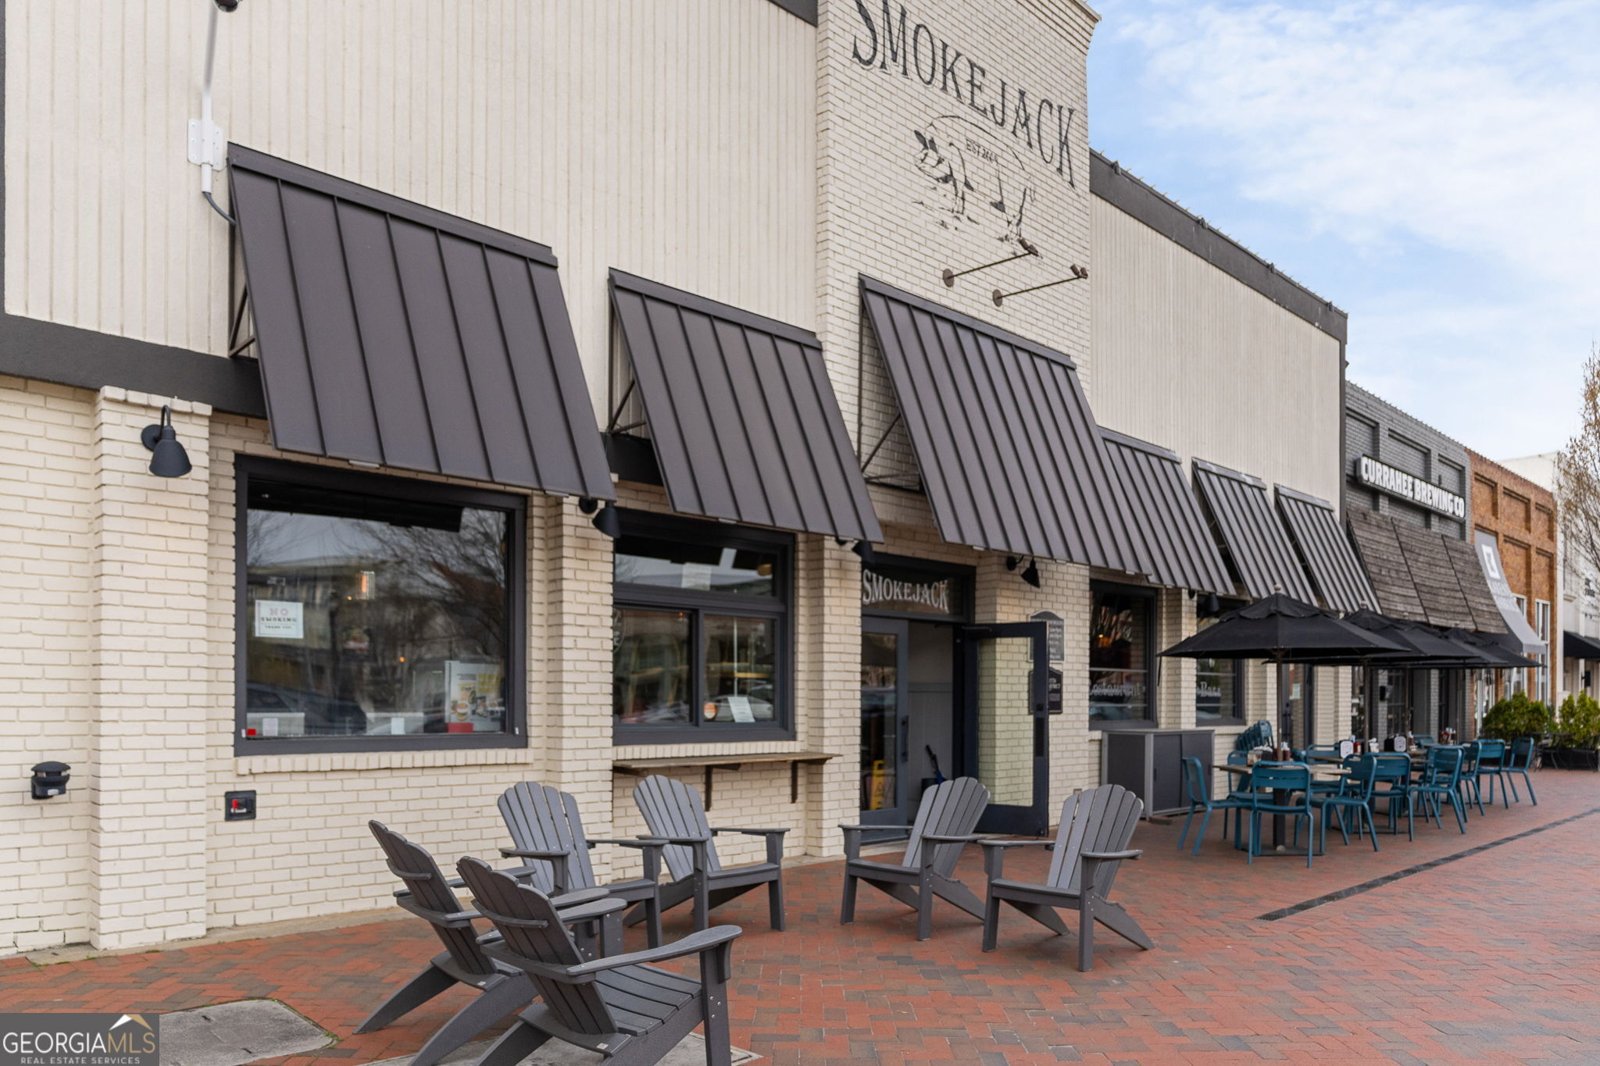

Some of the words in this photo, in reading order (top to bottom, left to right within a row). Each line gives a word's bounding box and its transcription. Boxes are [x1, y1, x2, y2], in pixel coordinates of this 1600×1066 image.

[853, 0, 1076, 189] SMOKEJACK
[1361, 456, 1413, 498] CURRAHEE
[1413, 478, 1454, 514] BREWING
[1454, 495, 1465, 518] CO
[863, 568, 949, 613] SMOKEJACK
